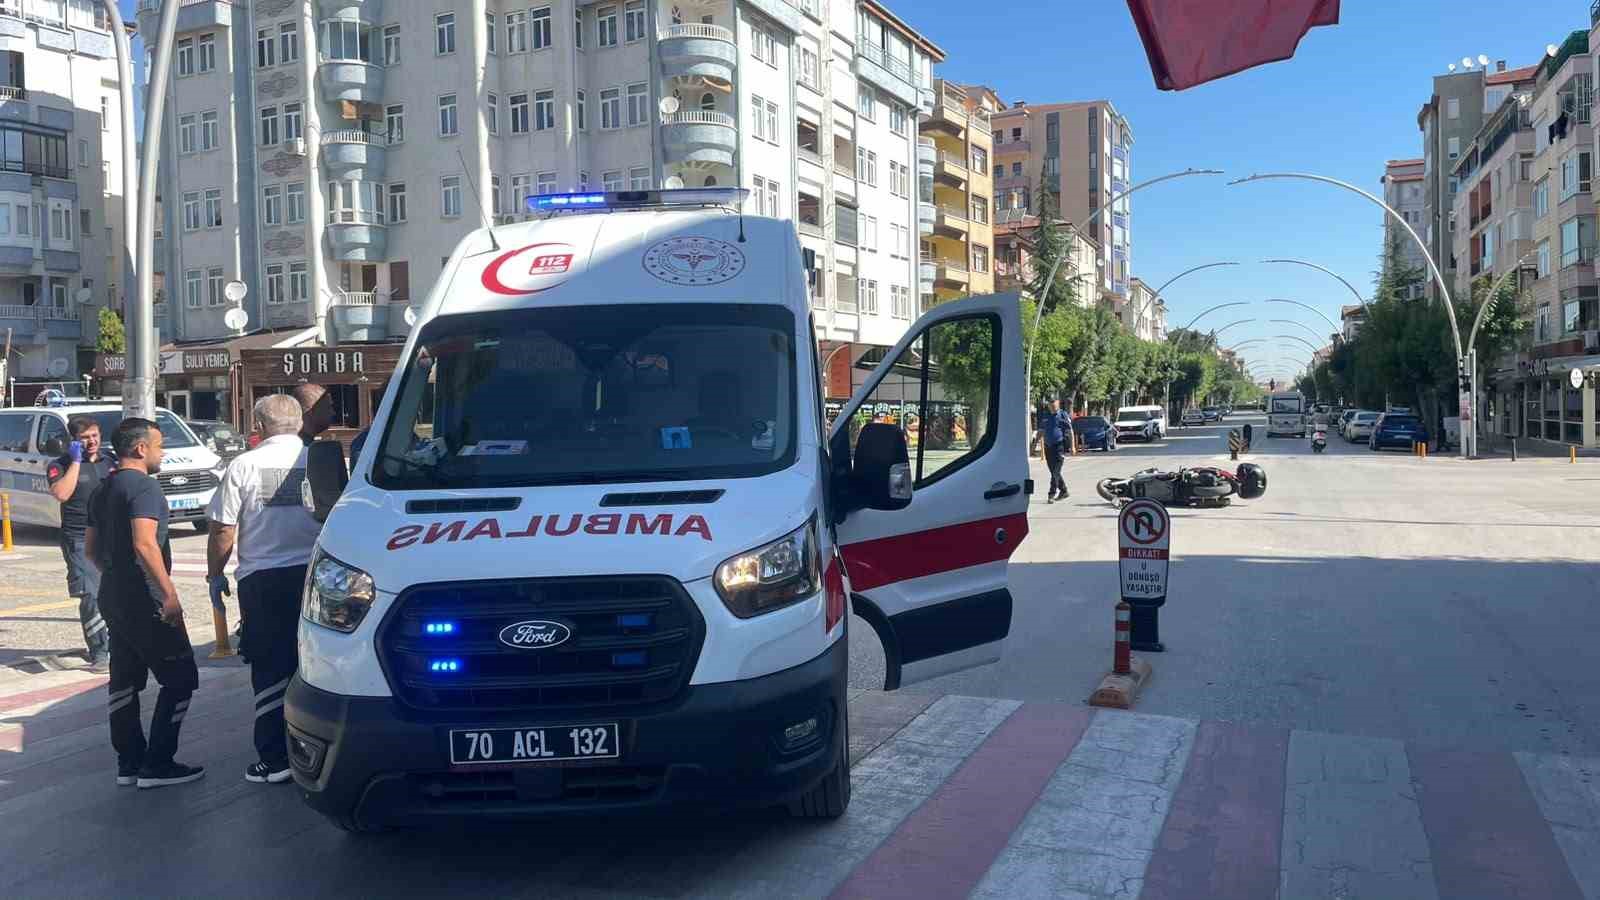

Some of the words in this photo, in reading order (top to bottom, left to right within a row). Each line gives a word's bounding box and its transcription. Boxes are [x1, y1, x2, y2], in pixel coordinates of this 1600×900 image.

[538, 255, 565, 267] 112
[104, 357, 126, 372] ŞORB
[186, 354, 203, 368] SULU
[204, 352, 230, 368] YEMEK
[284, 351, 363, 375] ŞORBA
[1141, 561, 1147, 570] U
[513, 623, 556, 643] Ford
[465, 732, 493, 760] 70
[513, 730, 554, 757] ACL
[570, 727, 608, 756] 132
